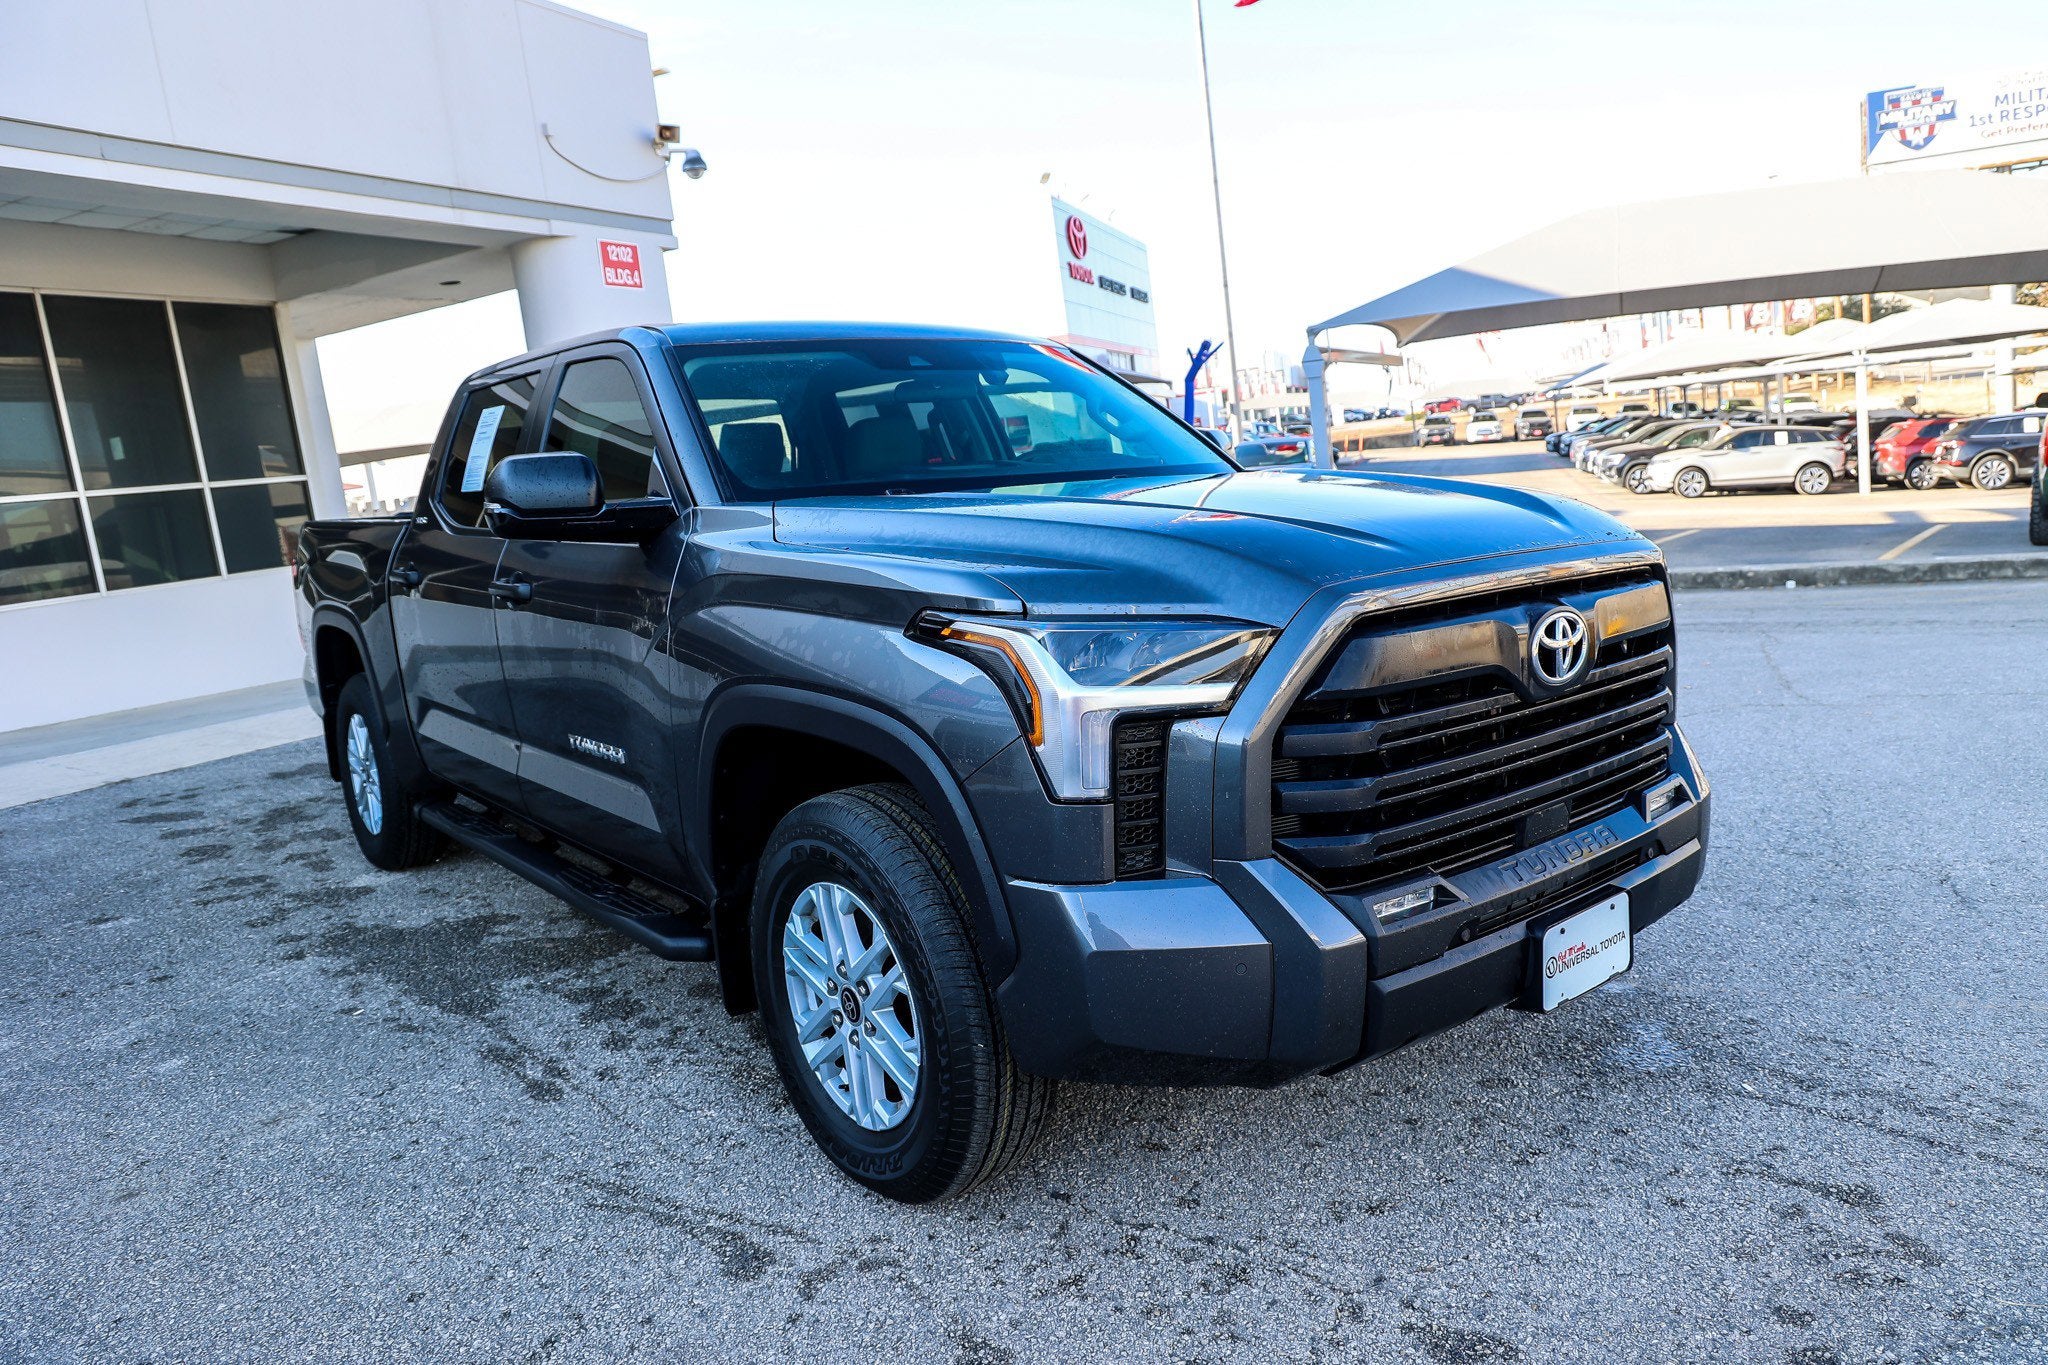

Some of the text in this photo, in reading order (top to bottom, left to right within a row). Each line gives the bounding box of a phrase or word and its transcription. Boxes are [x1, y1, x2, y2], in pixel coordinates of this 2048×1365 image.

[1994, 87, 2048, 107] MILIT
[1969, 103, 2048, 127] 1st RESP
[606, 244, 634, 263] 12102
[1498, 824, 1619, 882] TUNDRA
[1558, 931, 1626, 973] UNIVERSAL TOYOTA
